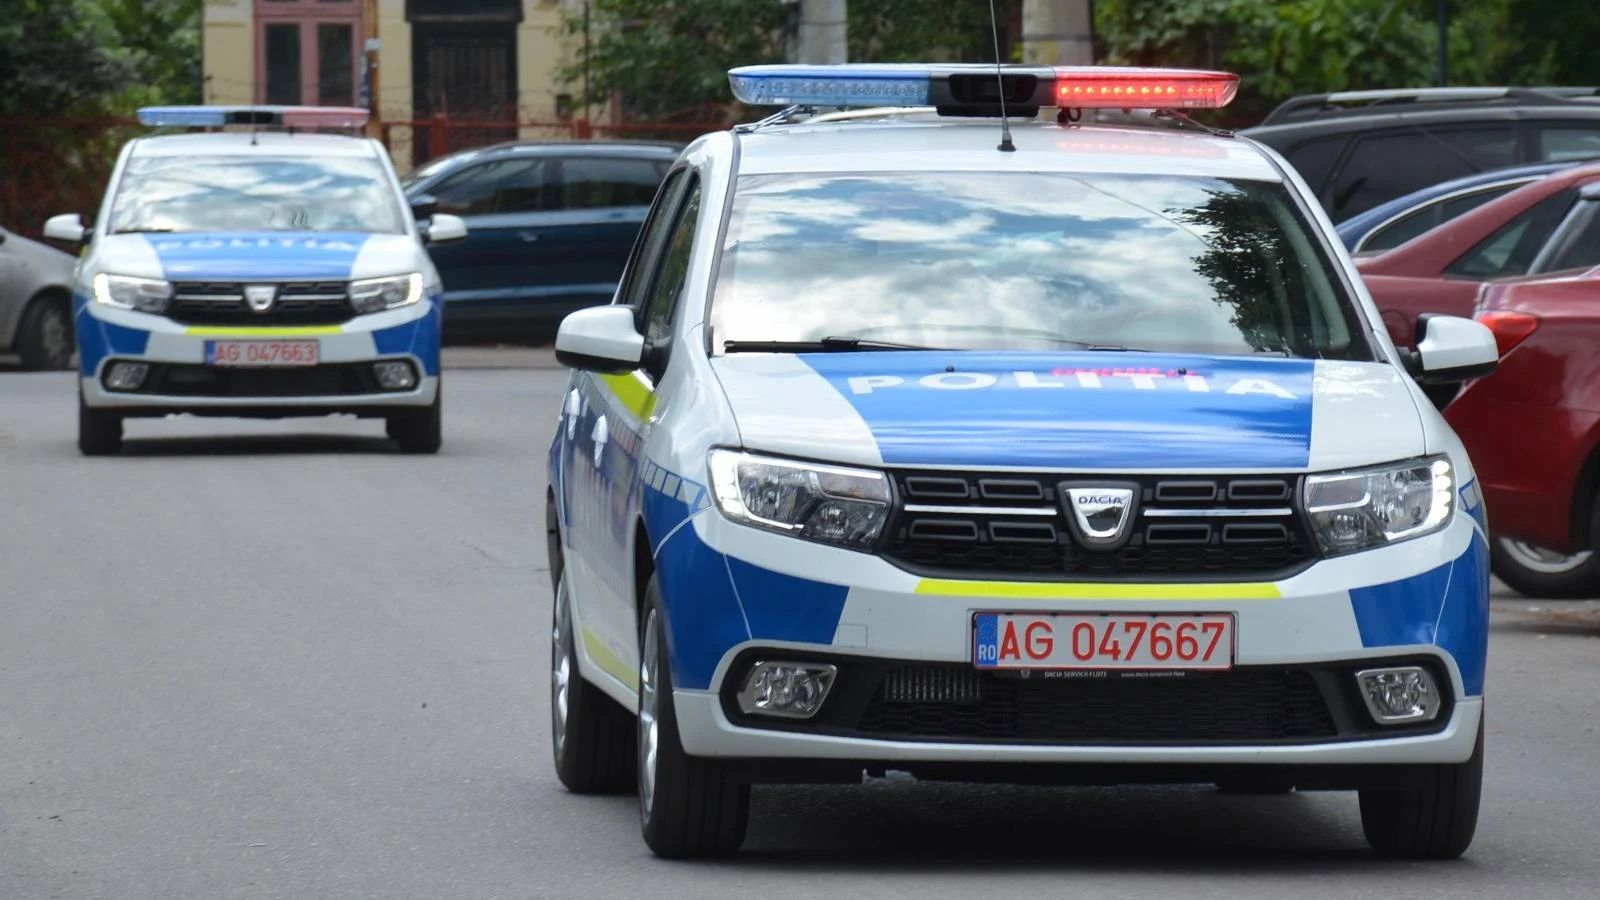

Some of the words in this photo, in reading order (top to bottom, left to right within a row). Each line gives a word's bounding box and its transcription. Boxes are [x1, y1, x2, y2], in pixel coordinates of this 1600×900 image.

[216, 343, 240, 361] AG
[247, 343, 315, 361] 047663
[1078, 495, 1123, 504] DACIA
[999, 620, 1054, 661] AG
[1072, 621, 1226, 662] 047667
[978, 644, 996, 661] RO
